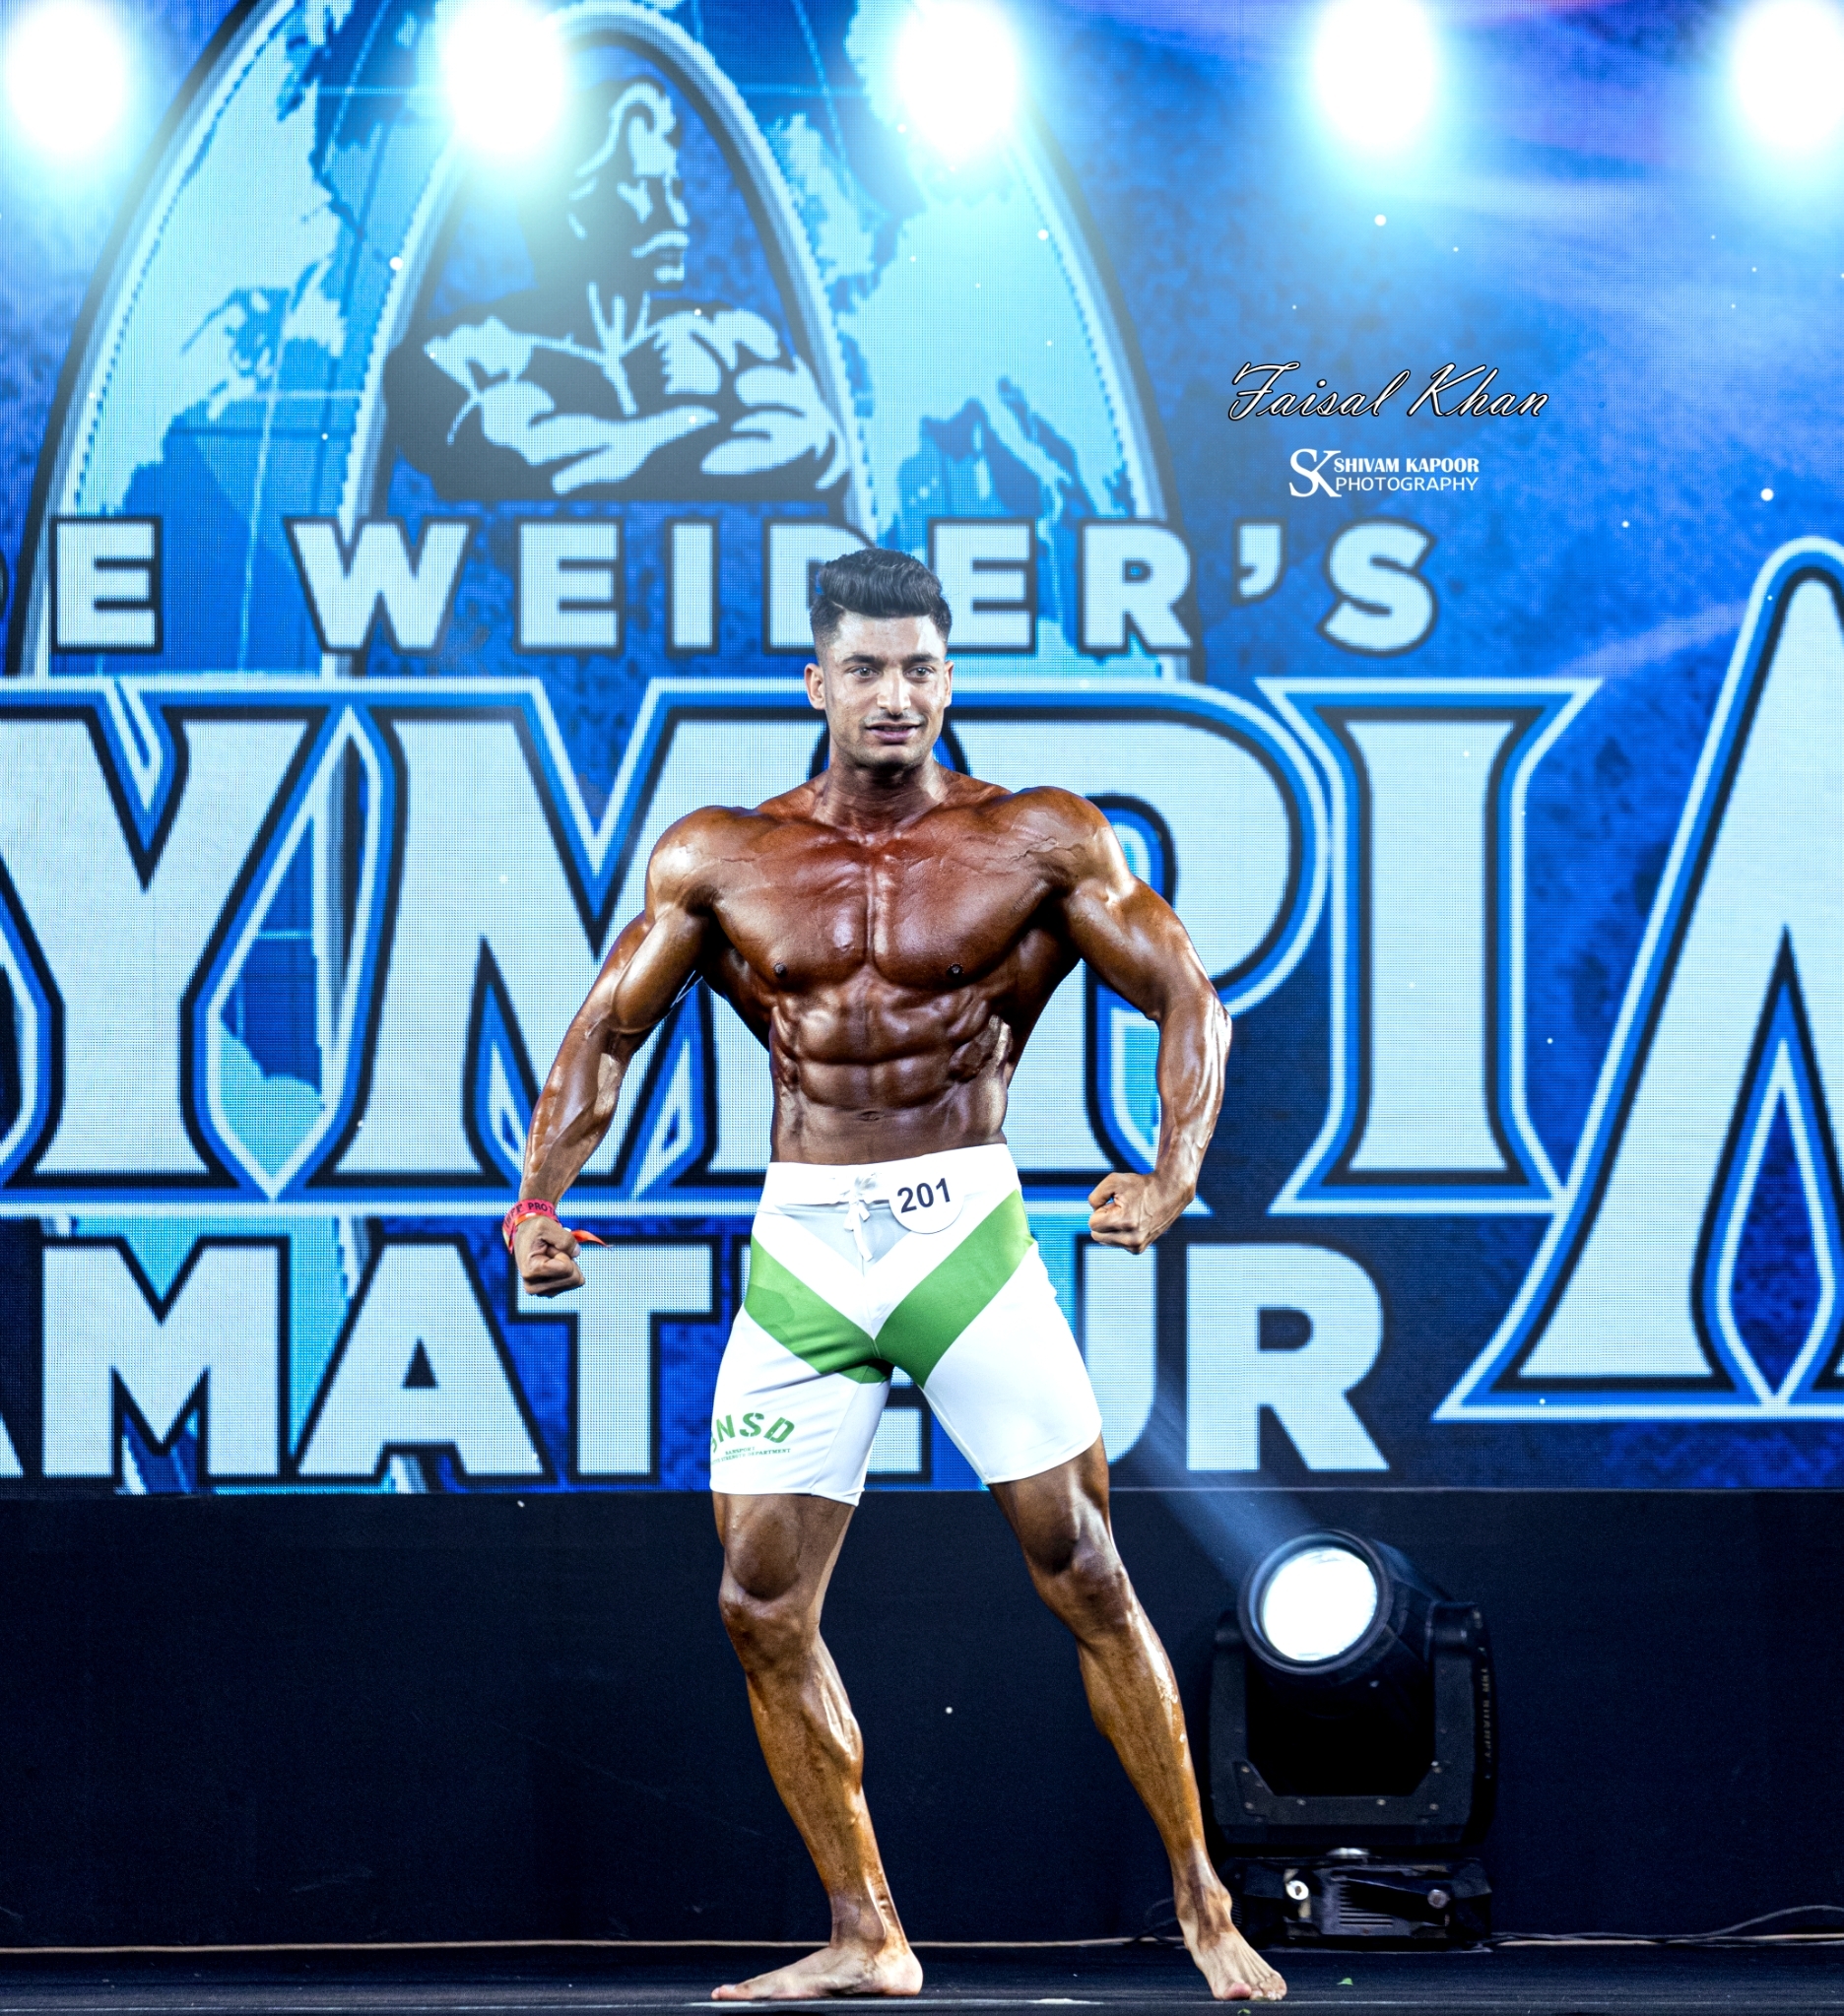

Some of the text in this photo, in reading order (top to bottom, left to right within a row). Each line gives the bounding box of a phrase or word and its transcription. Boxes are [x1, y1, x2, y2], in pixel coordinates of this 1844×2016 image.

[0, 519, 163, 654] E
[528, 1202, 548, 1211] PRO
[897, 1177, 951, 1213] 201
[711, 1412, 795, 1453] NSD
